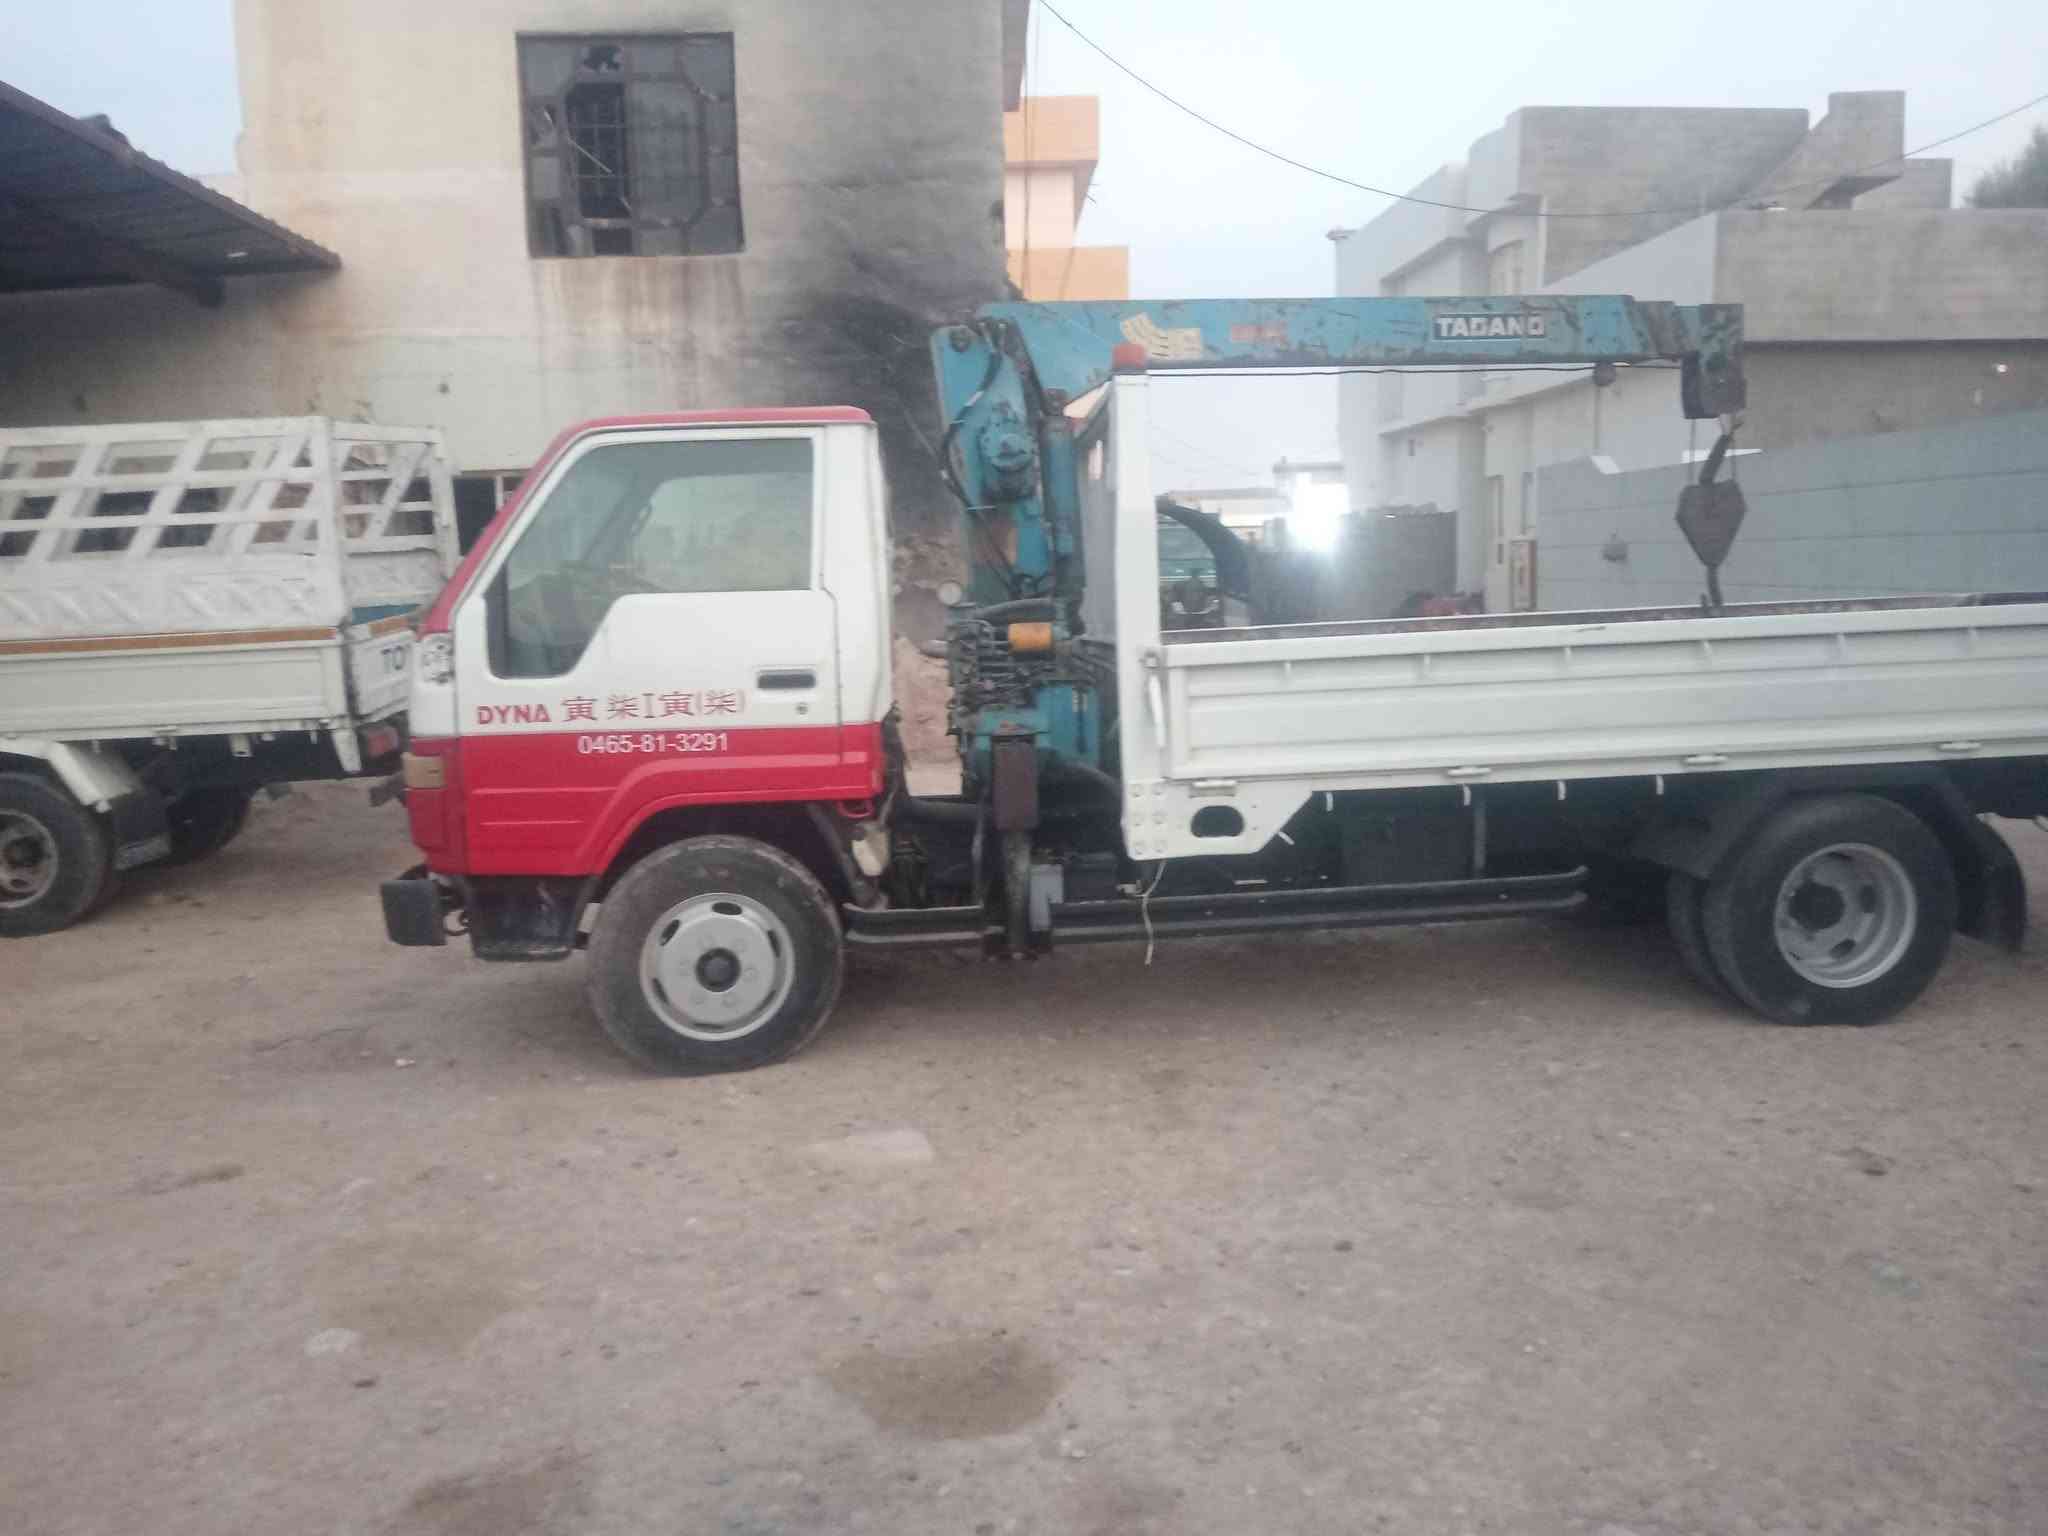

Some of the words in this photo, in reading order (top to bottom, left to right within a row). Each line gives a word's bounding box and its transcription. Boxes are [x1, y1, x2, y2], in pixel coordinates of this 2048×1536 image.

[1438, 316, 1545, 337] TADANO
[477, 703, 552, 725] DYNA
[577, 732, 729, 754] 0465-81-3291
